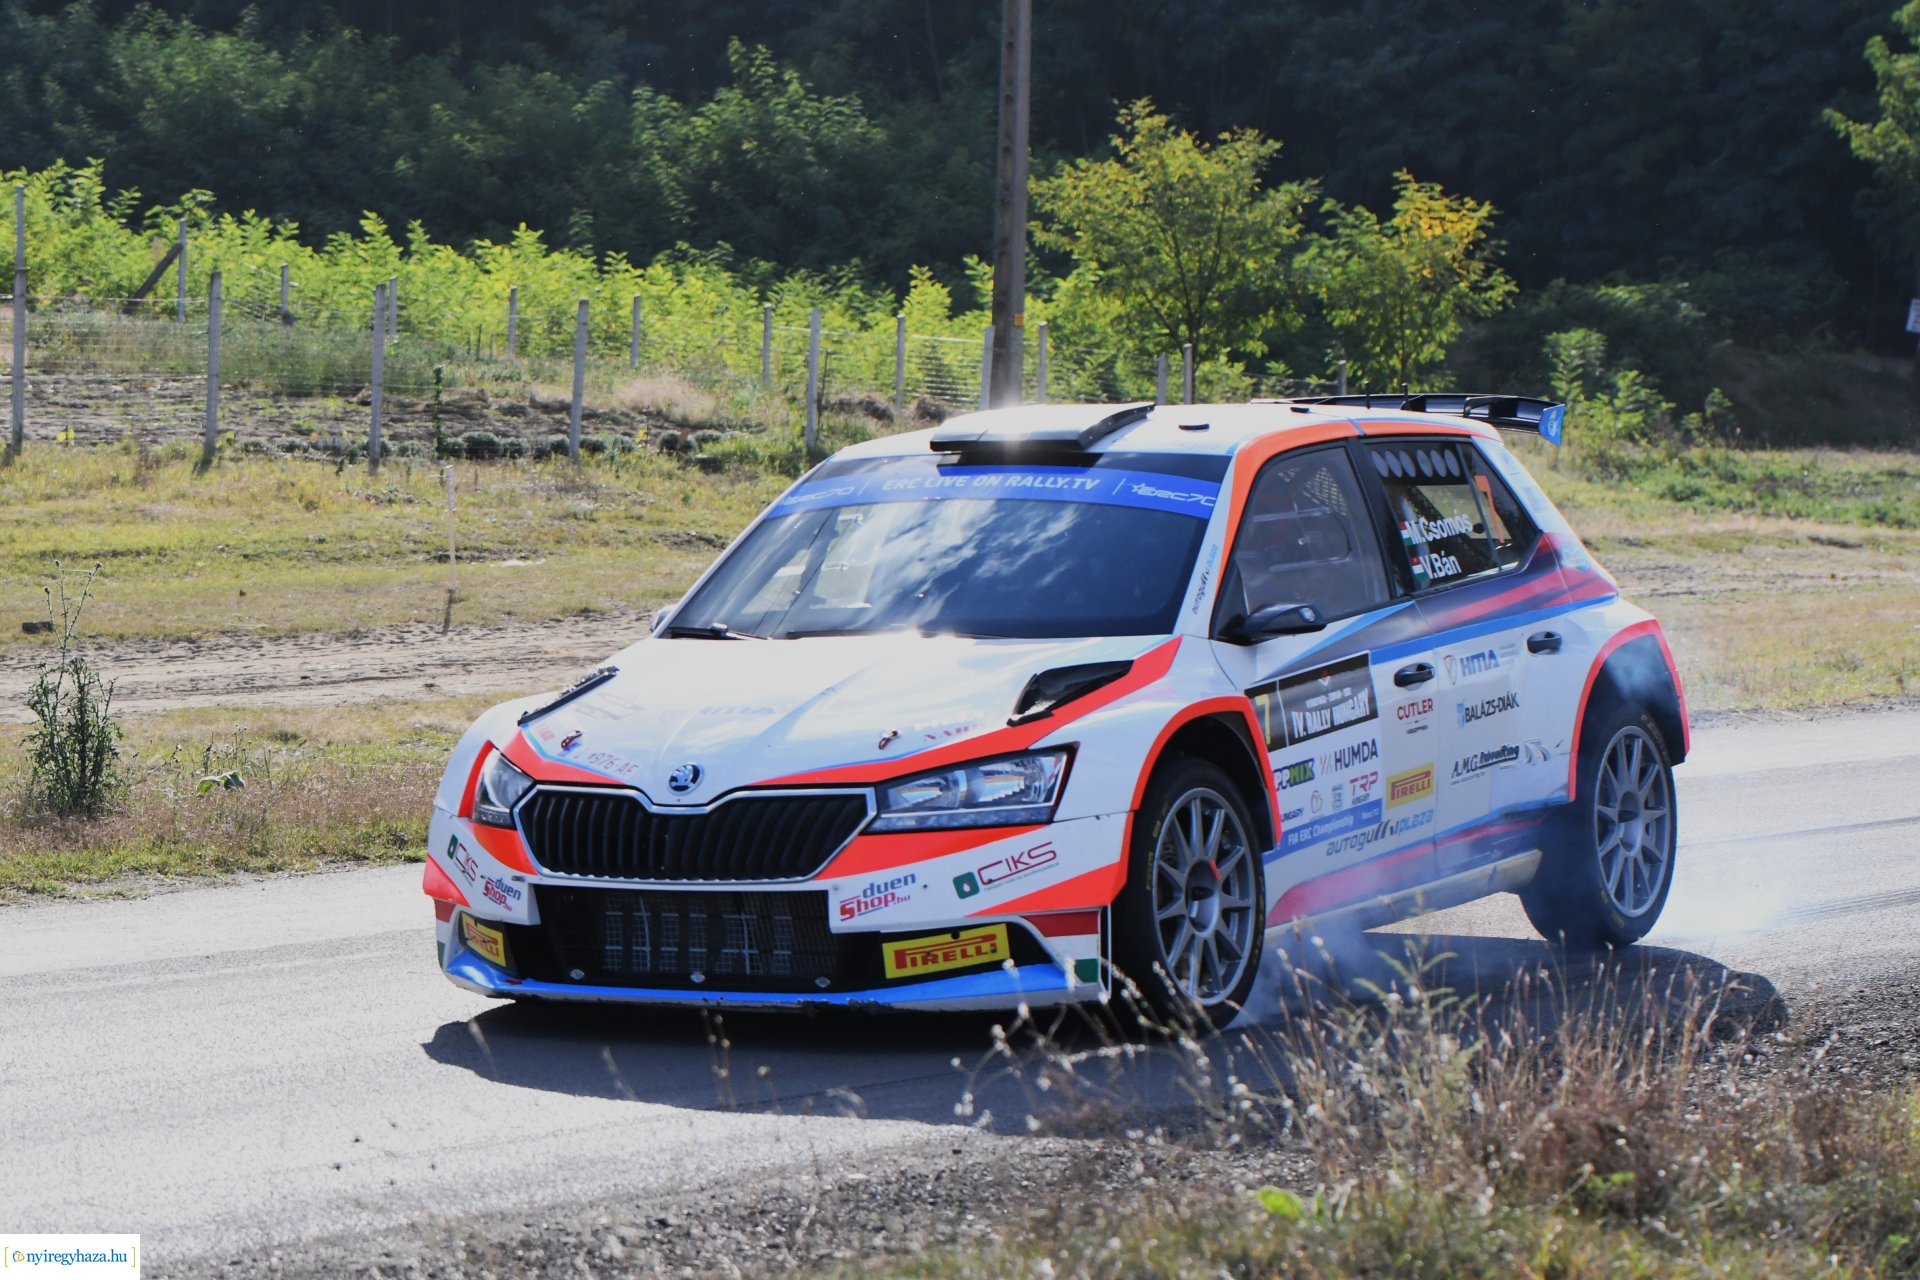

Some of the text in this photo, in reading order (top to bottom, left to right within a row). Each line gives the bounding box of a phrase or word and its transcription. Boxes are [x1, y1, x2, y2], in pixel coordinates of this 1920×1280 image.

[881, 475, 1100, 491] ERC LIVE ON RALLY.TV
[1419, 551, 1462, 580] V.Bán
[1254, 693, 1271, 745] 7
[1304, 708, 1331, 735] RALLY
[1332, 688, 1370, 726] HUNGARY
[1397, 698, 1433, 721] CUTLER
[1465, 691, 1520, 722] BALÁZS-DIÁK
[1334, 738, 1379, 772] HUMDA
[1350, 771, 1378, 797] TRP
[1391, 769, 1432, 801] PIRELLI
[977, 841, 1057, 886] CIKS
[494, 877, 521, 901] duen
[862, 873, 917, 899] duen
[839, 891, 911, 922] Shop.hu
[894, 933, 997, 970] PIRELLI
